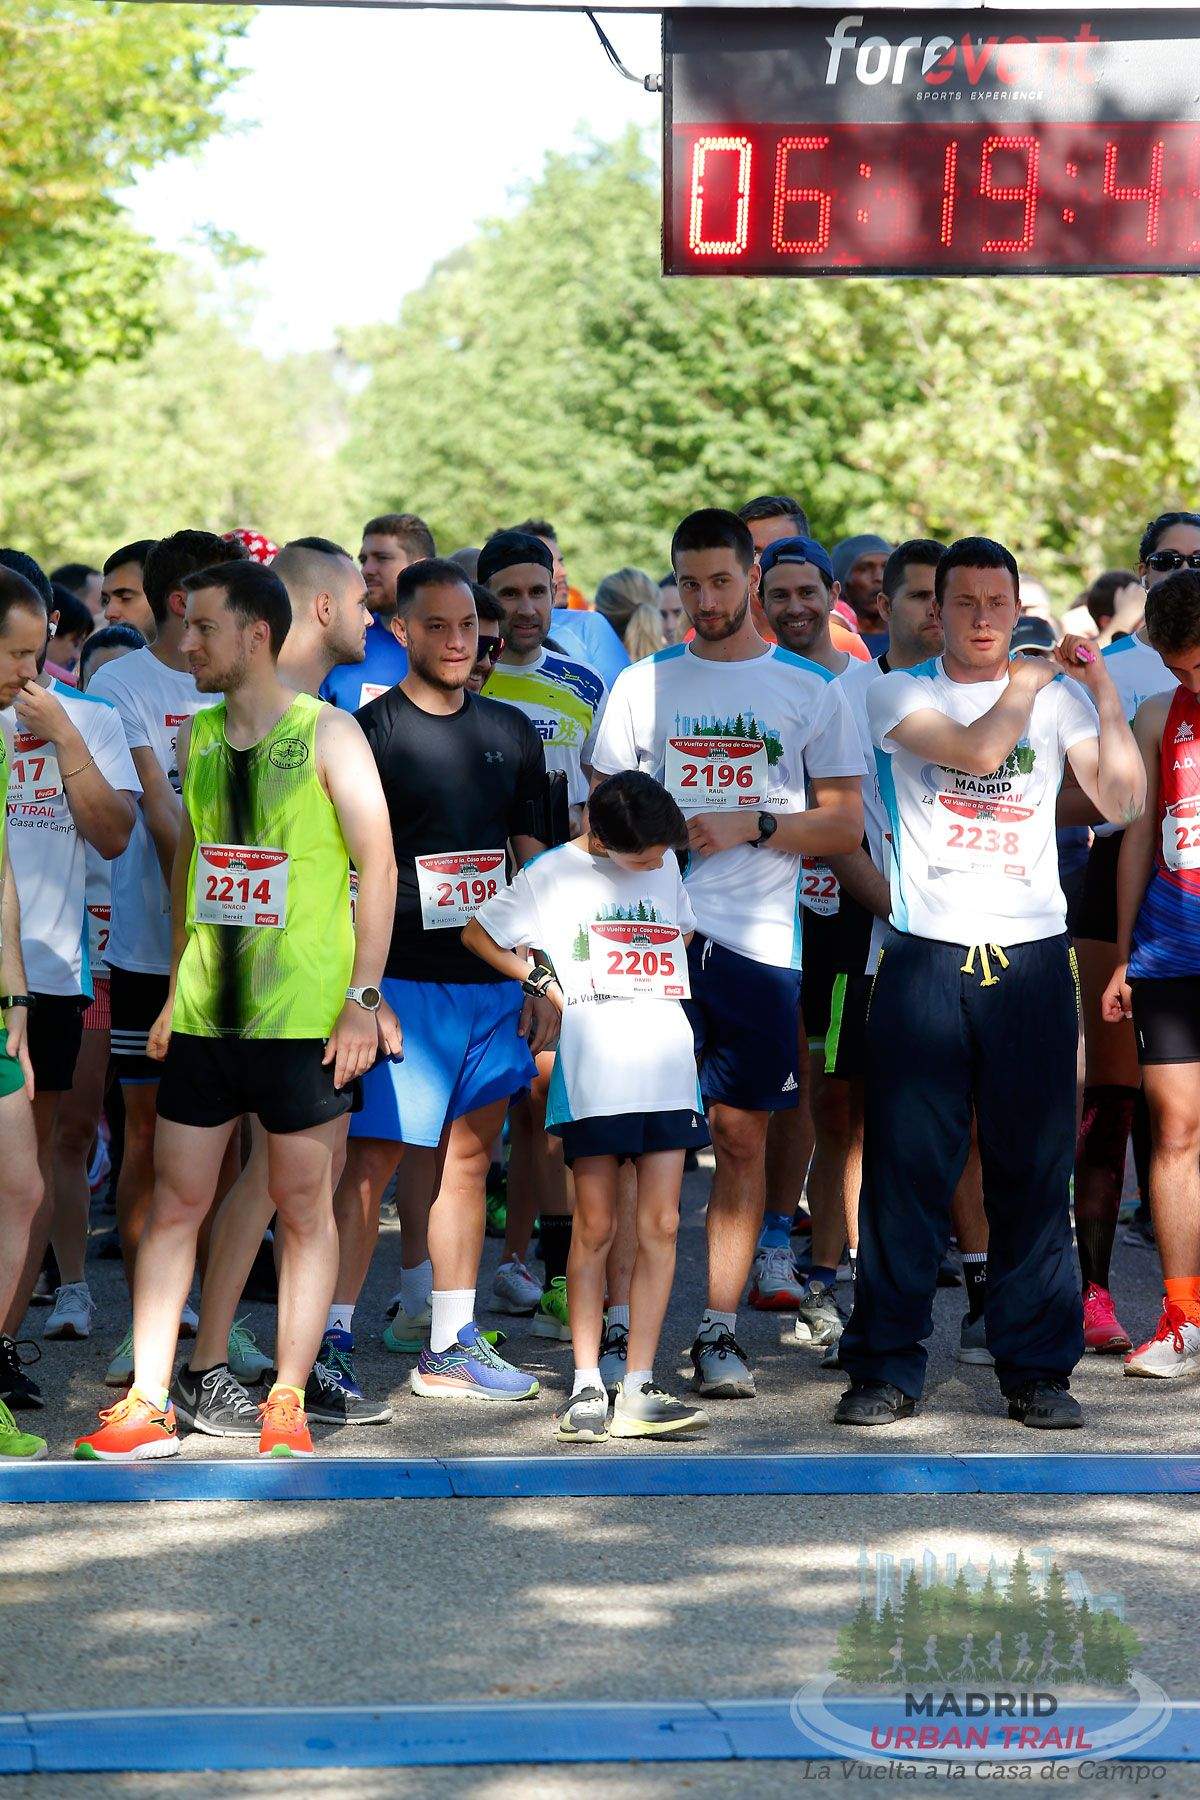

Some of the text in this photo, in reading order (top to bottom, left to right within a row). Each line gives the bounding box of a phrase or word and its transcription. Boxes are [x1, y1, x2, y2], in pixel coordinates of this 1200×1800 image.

[825, 15, 1101, 86] forevent
[916, 91, 1044, 101] SPORTS EXPERIENCE
[680, 764, 753, 788] 2196
[955, 777, 1012, 795] MADRID
[922, 795, 934, 805] La
[952, 799, 972, 808] Vuelta
[22, 804, 55, 818] TRAIL
[10, 817, 76, 835] Casa de Campo
[946, 824, 1019, 855] 2238
[260, 853, 283, 861] Campo
[205, 875, 271, 904] 2214
[437, 879, 497, 907] 2198
[222, 903, 246, 911] IGNACIO
[607, 951, 675, 976] 2205
